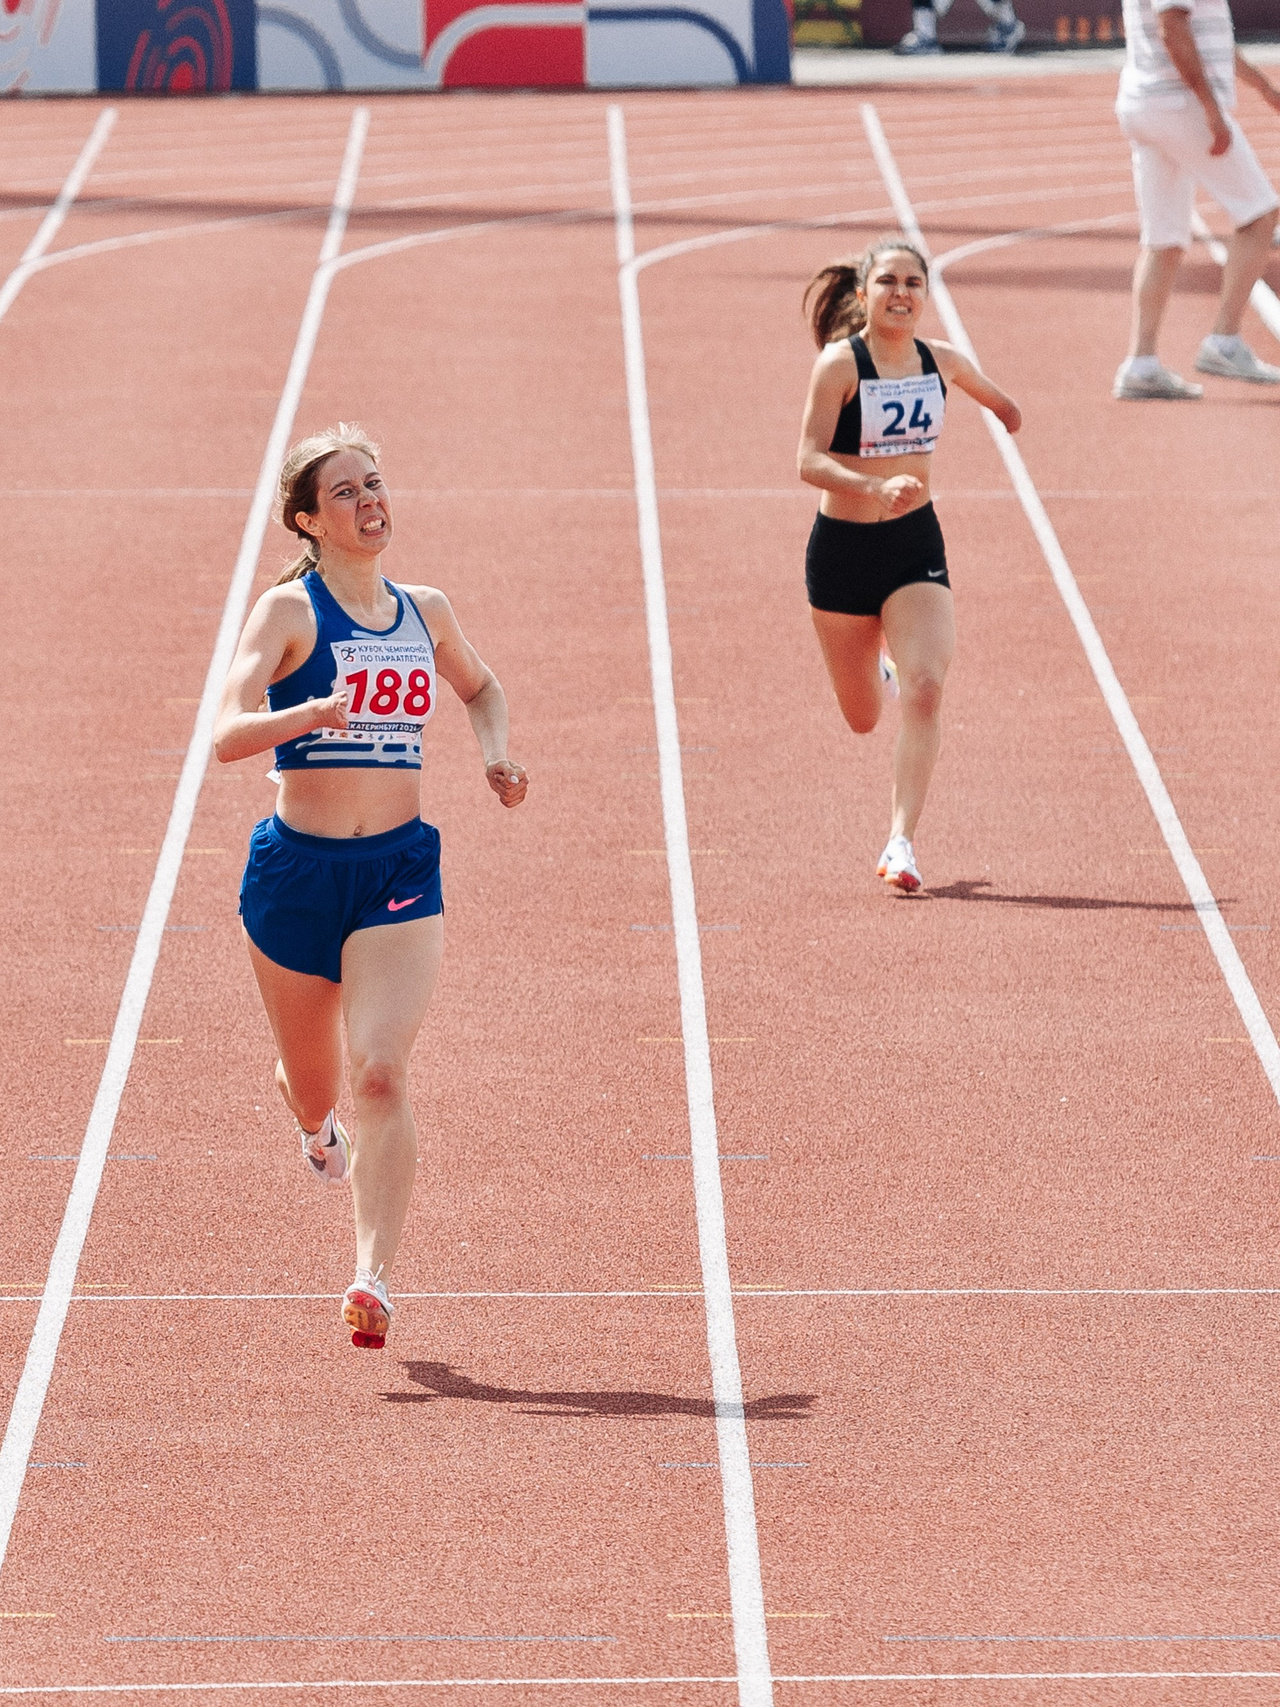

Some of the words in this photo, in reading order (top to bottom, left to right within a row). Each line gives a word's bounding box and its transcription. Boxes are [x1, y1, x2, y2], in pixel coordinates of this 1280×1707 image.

[882, 398, 932, 436] 24
[357, 645, 383, 653] КУБОК
[360, 654, 373, 663] ПО
[375, 654, 431, 664] ПАРААТЛЕТИКЕ
[345, 668, 431, 717] 188
